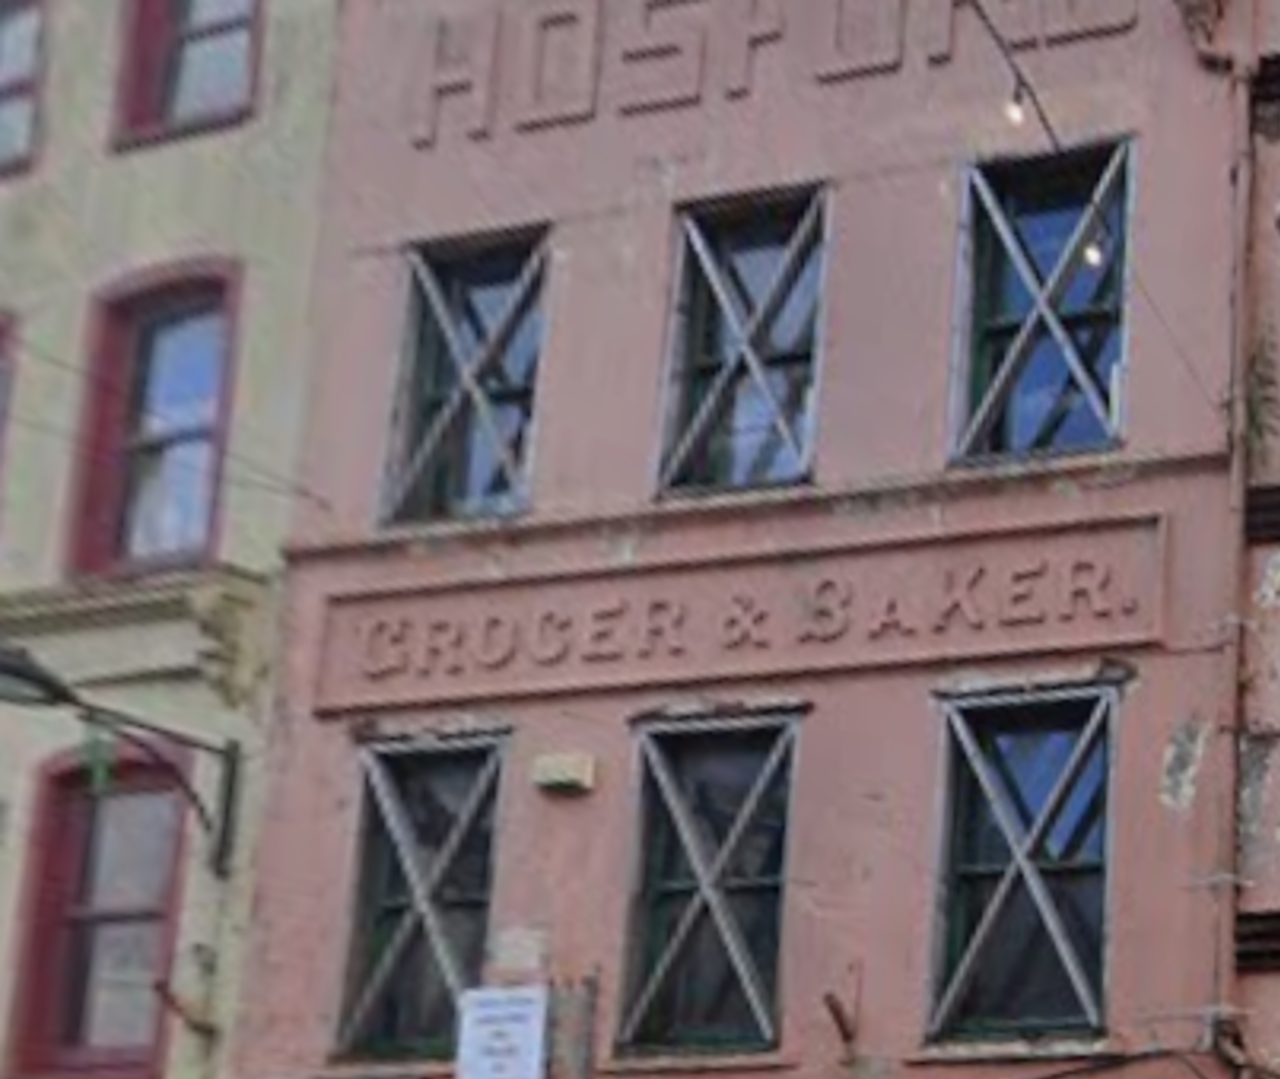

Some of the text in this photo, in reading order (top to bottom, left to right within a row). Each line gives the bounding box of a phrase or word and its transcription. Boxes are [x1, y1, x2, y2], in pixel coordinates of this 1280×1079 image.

[357, 560, 1140, 682] GROCER & BAKER.
